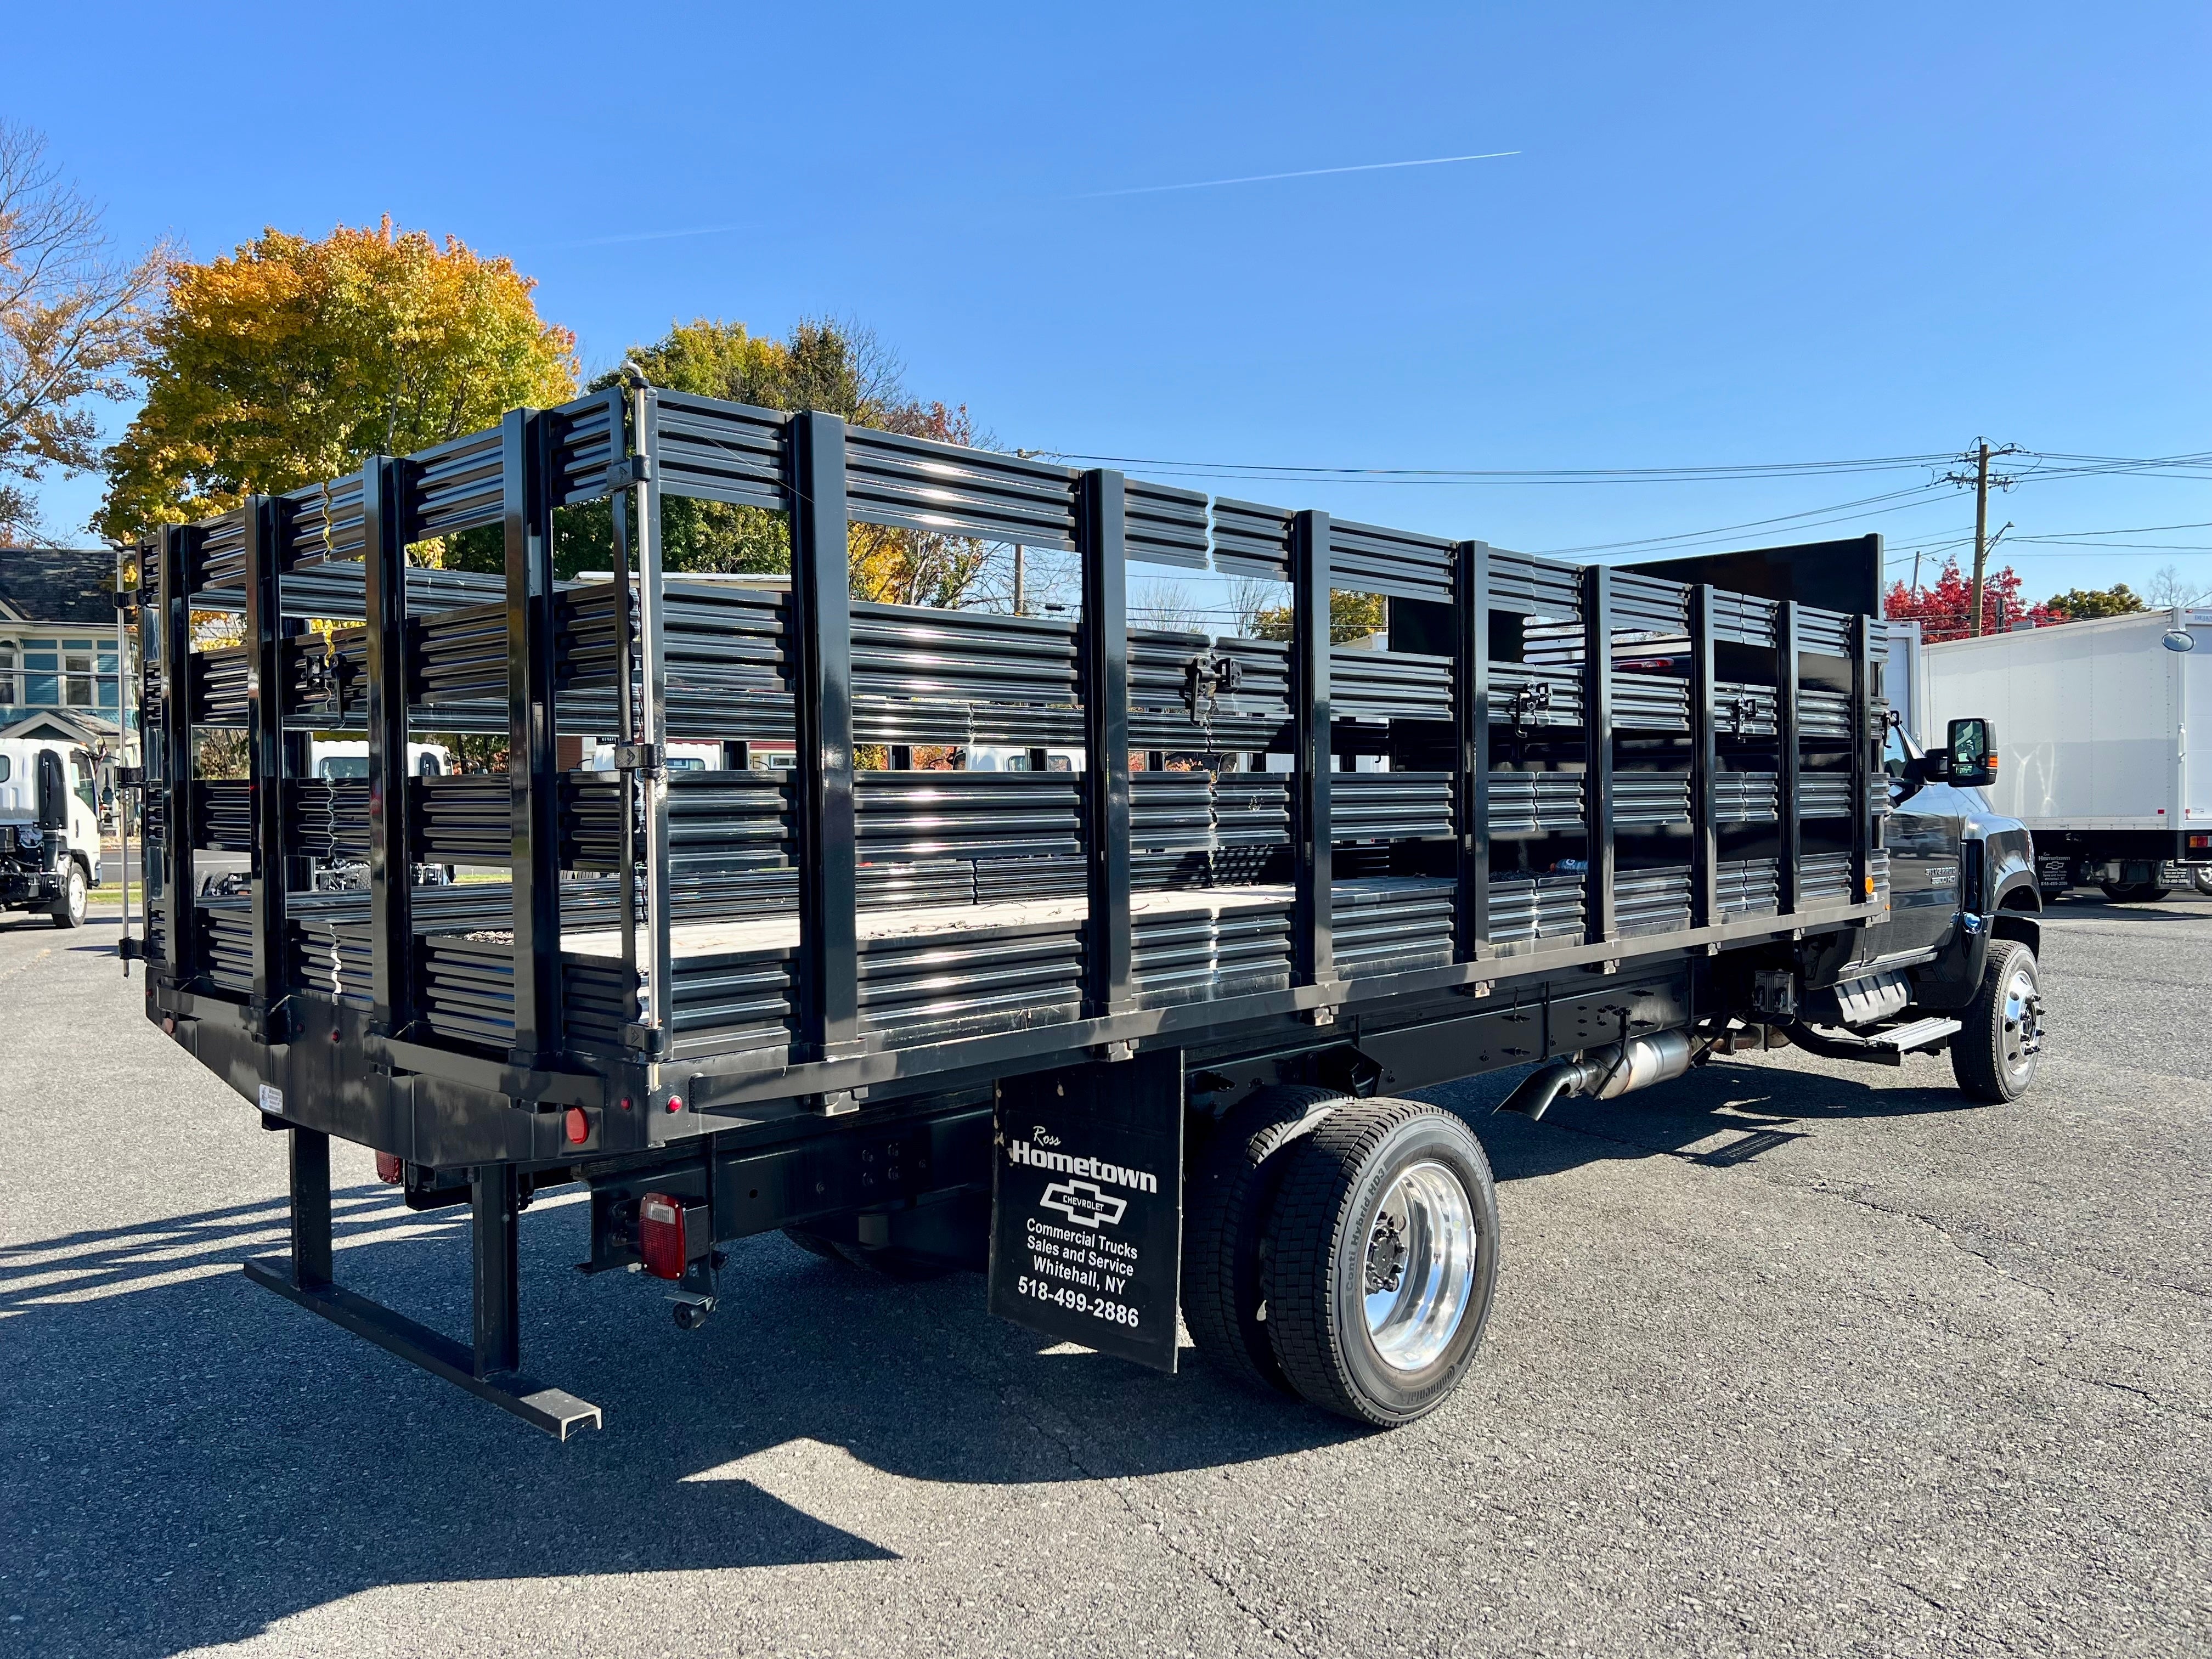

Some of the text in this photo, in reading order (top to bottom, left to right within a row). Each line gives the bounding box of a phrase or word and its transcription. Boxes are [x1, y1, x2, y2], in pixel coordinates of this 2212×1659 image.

[1033, 1125, 1061, 1147] Ross
[1012, 1139, 1158, 1194] Hometown
[1063, 1194, 1105, 1212] CHEVROLET
[1026, 1217, 1138, 1260] Commercial Trucks
[1346, 1167, 1385, 1291] Conti Hybrid HD3
[1026, 1235, 1134, 1277] Sales and Service
[1033, 1254, 1126, 1295] Whitehall, NY
[1018, 1276, 1139, 1328] 518-499-2886
